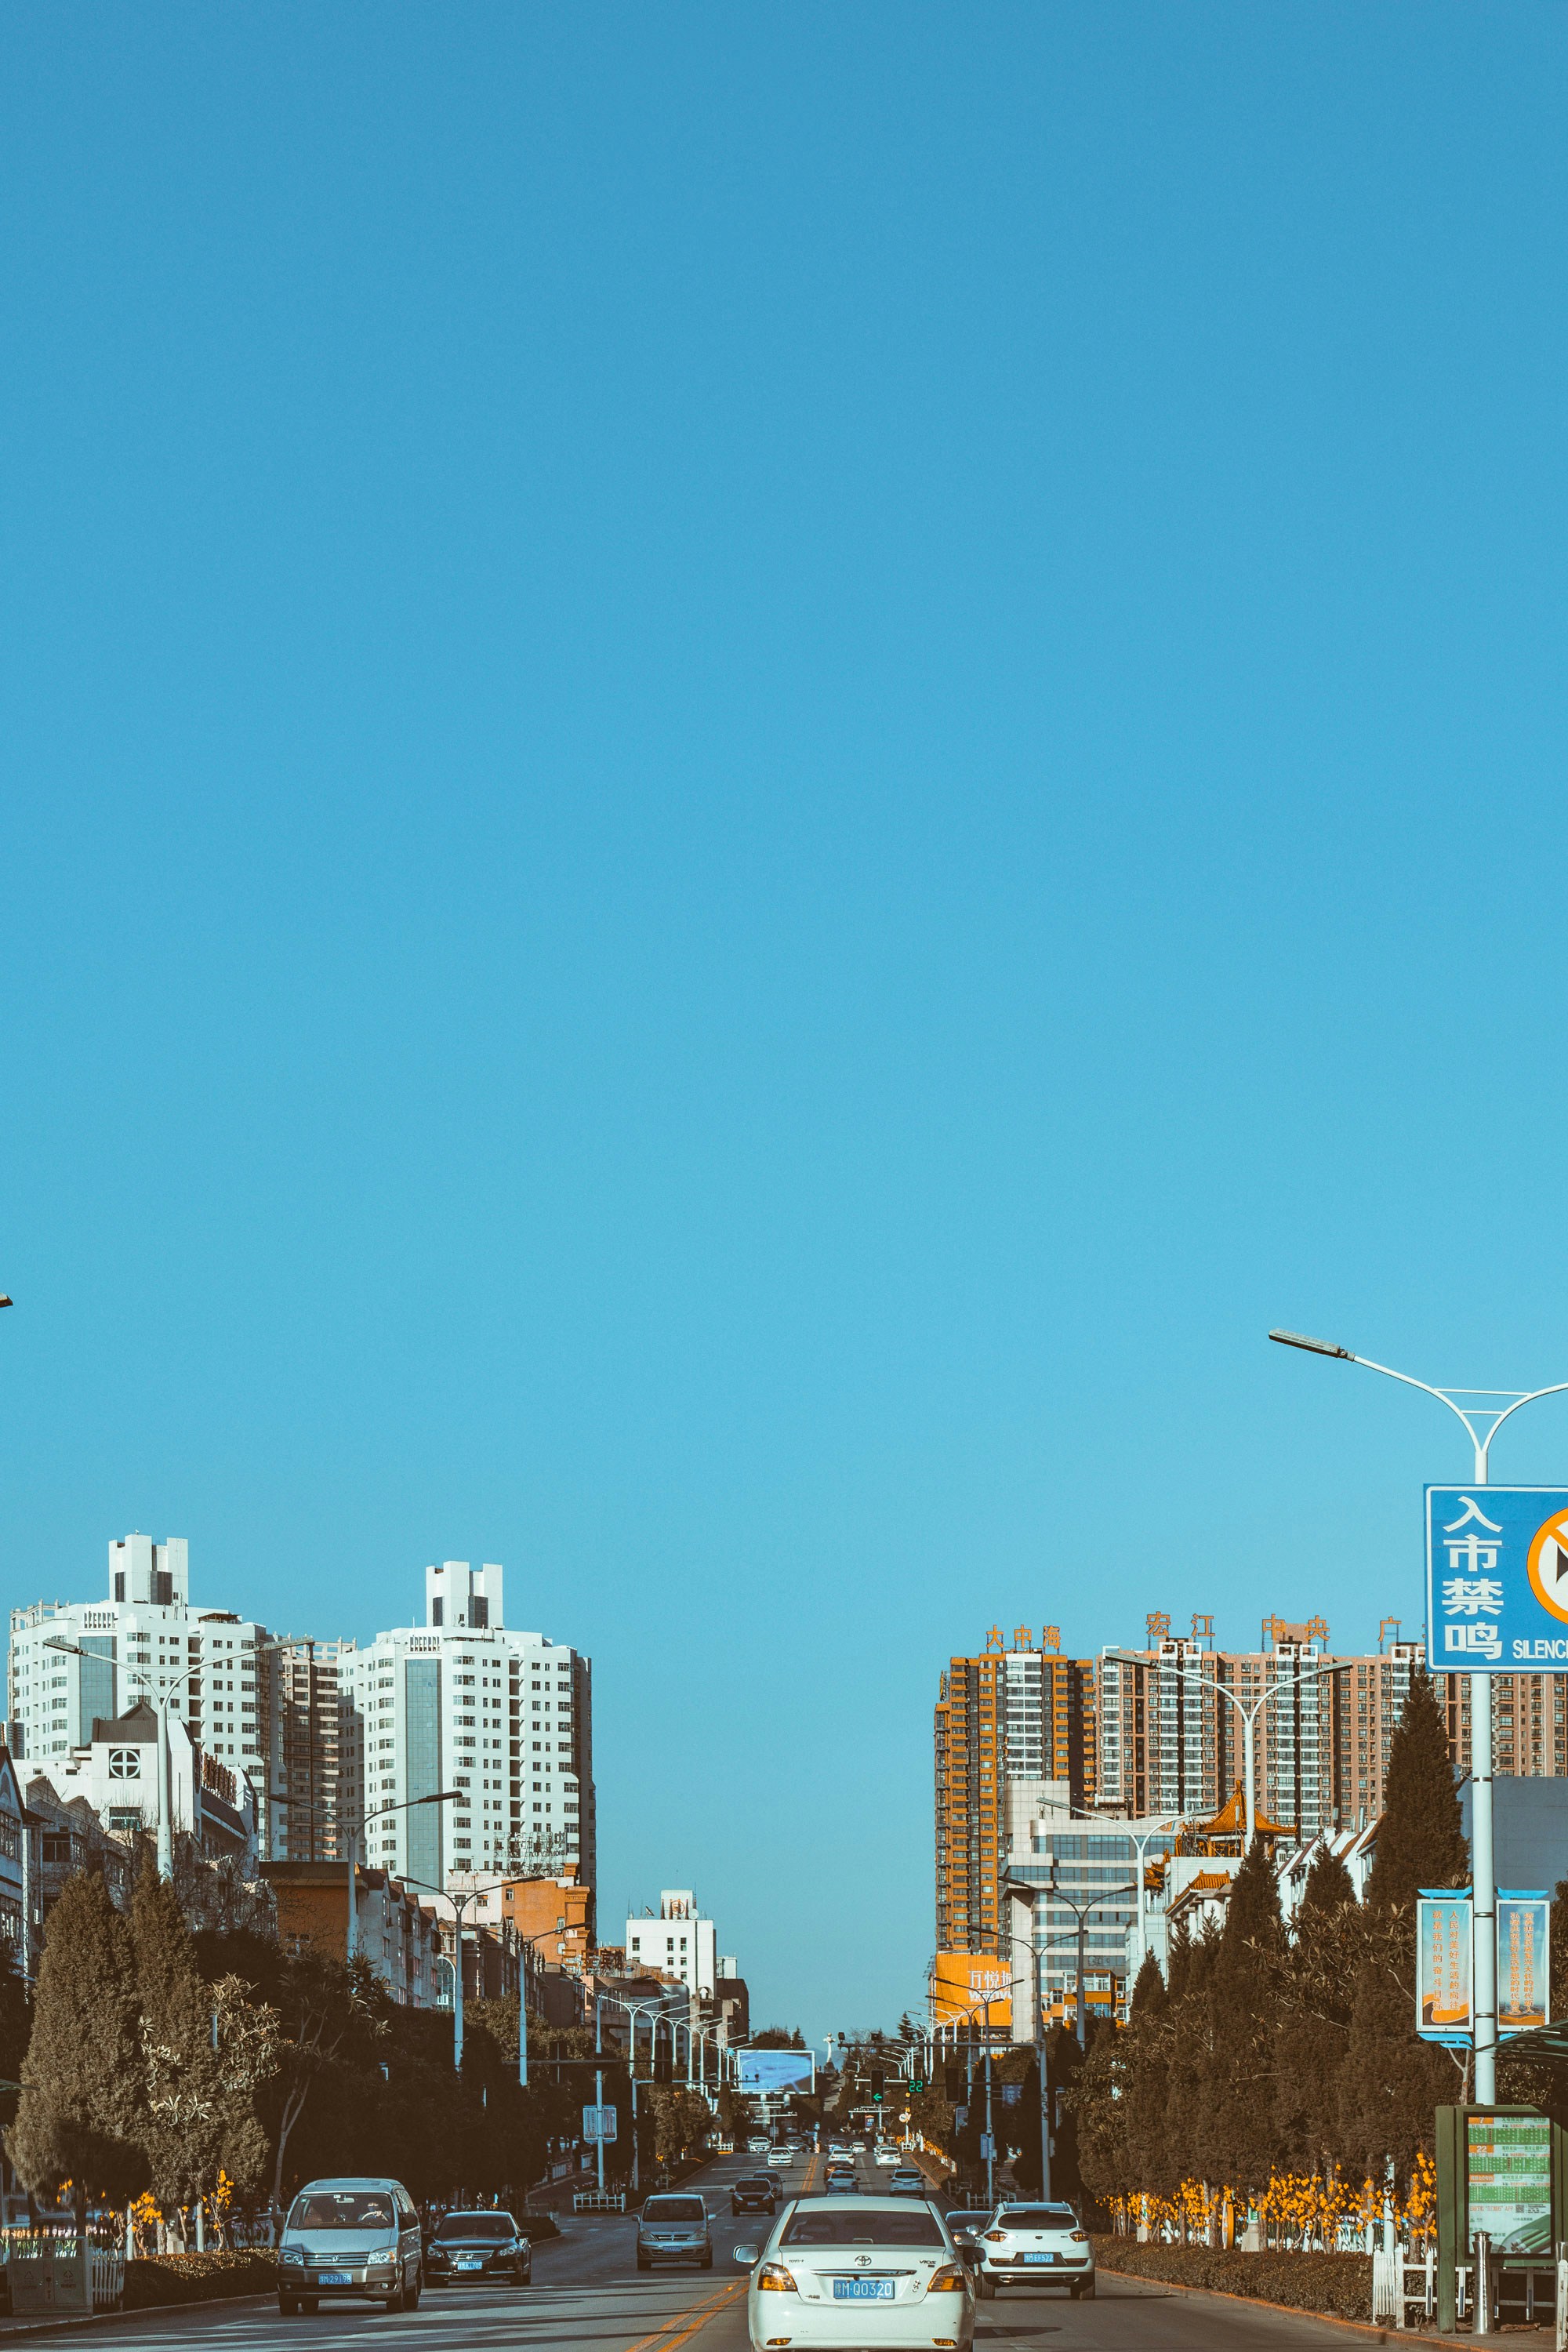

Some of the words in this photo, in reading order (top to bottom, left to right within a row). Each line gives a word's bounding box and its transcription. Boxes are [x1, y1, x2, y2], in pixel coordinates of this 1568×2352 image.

[1442, 1495, 1504, 1660] 入市禁鸣
[986, 1624, 1062, 1649] 大中海
[1145, 1611, 1425, 1642] 宏江中央广
[1512, 1639, 1568, 1659] SILENC
[1432, 1911, 1443, 2010] 就是我们的奋斗目标
[1449, 1911, 1459, 2010] 人民对美好生活的向往
[909, 2080, 923, 2092] 22
